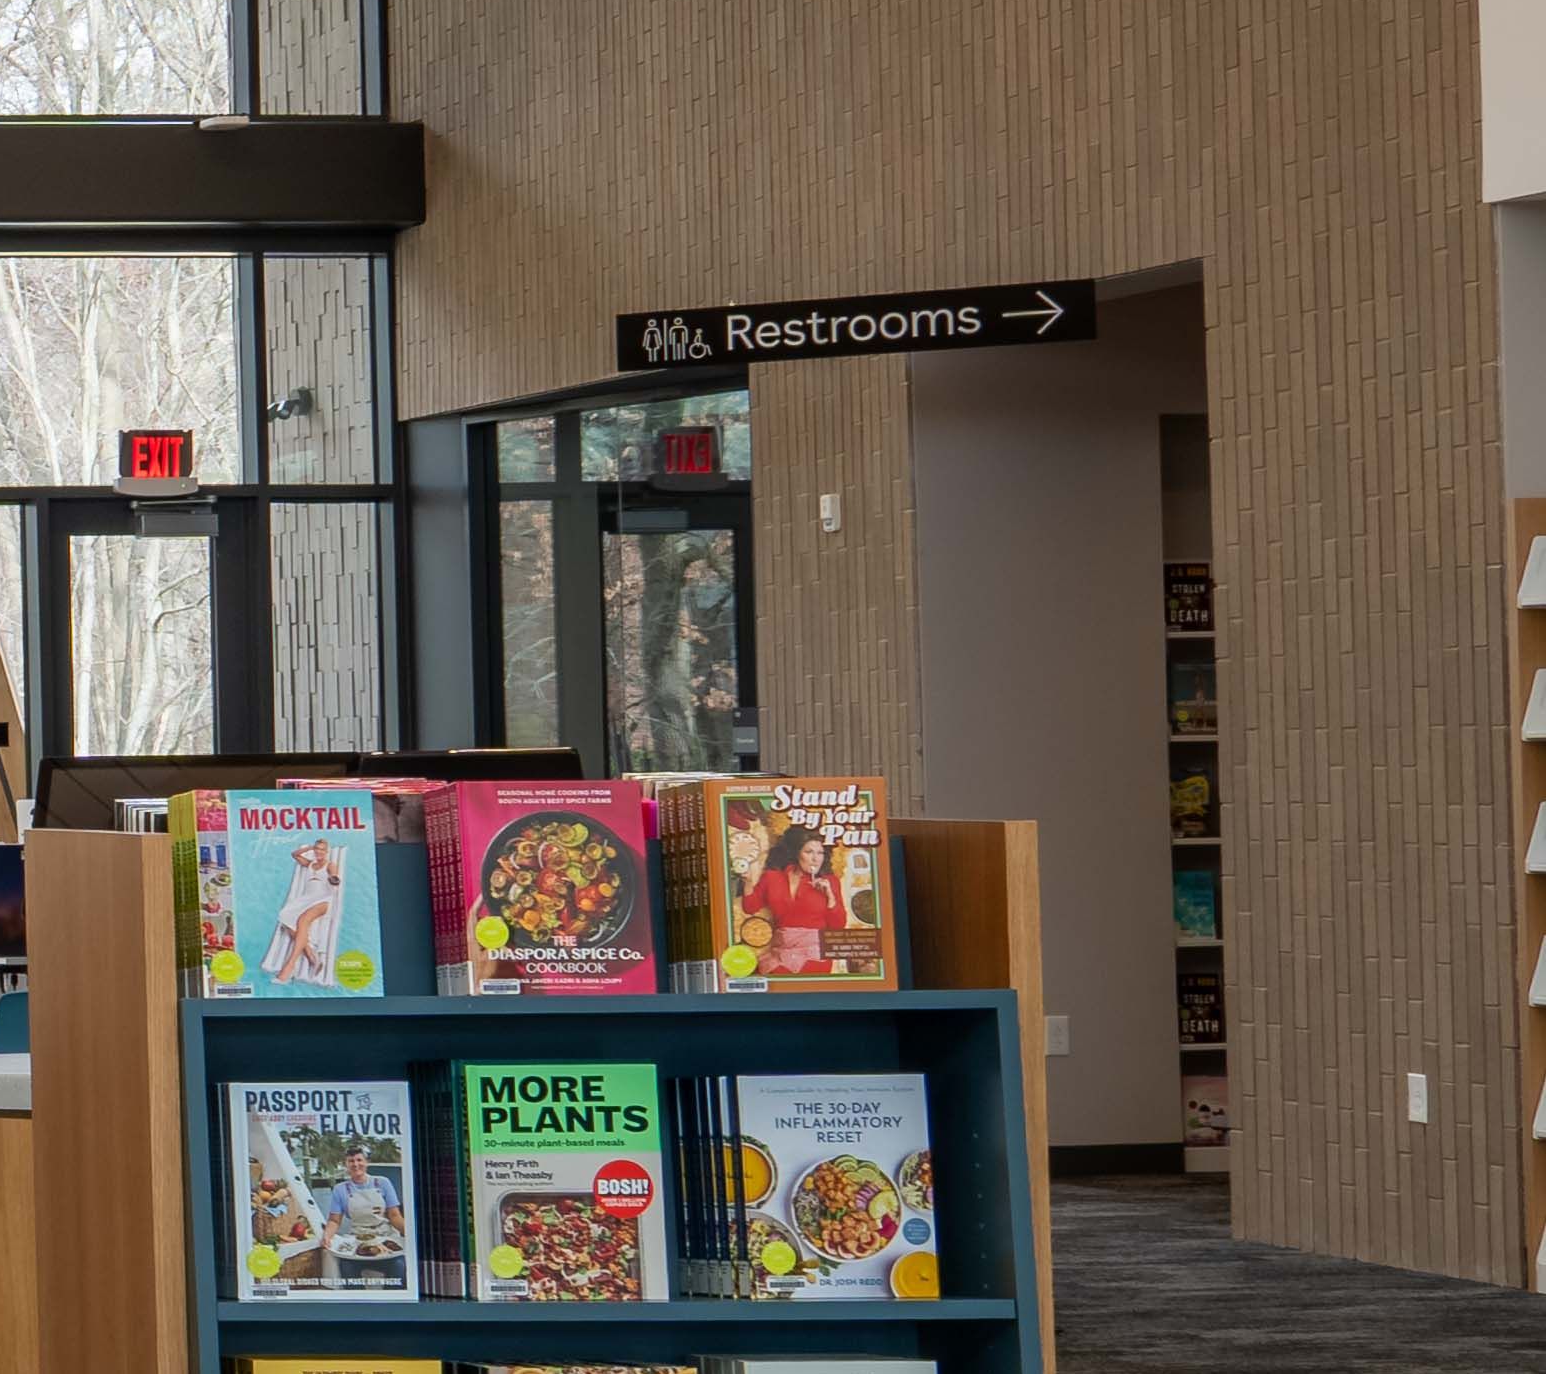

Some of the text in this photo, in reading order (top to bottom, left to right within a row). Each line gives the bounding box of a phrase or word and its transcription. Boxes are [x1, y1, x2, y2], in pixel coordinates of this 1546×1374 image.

[725, 305, 982, 351] Restrooms
[130, 436, 185, 478] EXIT
[771, 785, 858, 811] Stand
[240, 807, 366, 830] MOCKTAIL
[789, 807, 875, 829] By Your
[819, 825, 881, 847] Pan
[552, 936, 577, 947] THE
[488, 948, 644, 960] DIASPORA SPICE Co.
[525, 963, 606, 974] COOKBOOK
[480, 1076, 605, 1103] MORE
[245, 1090, 352, 1113] PASSPORT
[794, 1102, 881, 1114] THE 30-DAY
[320, 1114, 401, 1135] FLAVOR
[482, 1106, 649, 1133] PLANTS
[775, 1117, 902, 1129] INFLAMMATORY
[484, 1139, 625, 1148] 30-minute plant-based meals
[817, 1131, 862, 1143] RESET
[485, 1159, 539, 1169] Henry Firth
[495, 1171, 511, 1179] Ian
[513, 1171, 553, 1181] Theasby
[598, 1179, 649, 1194] BOSH!
